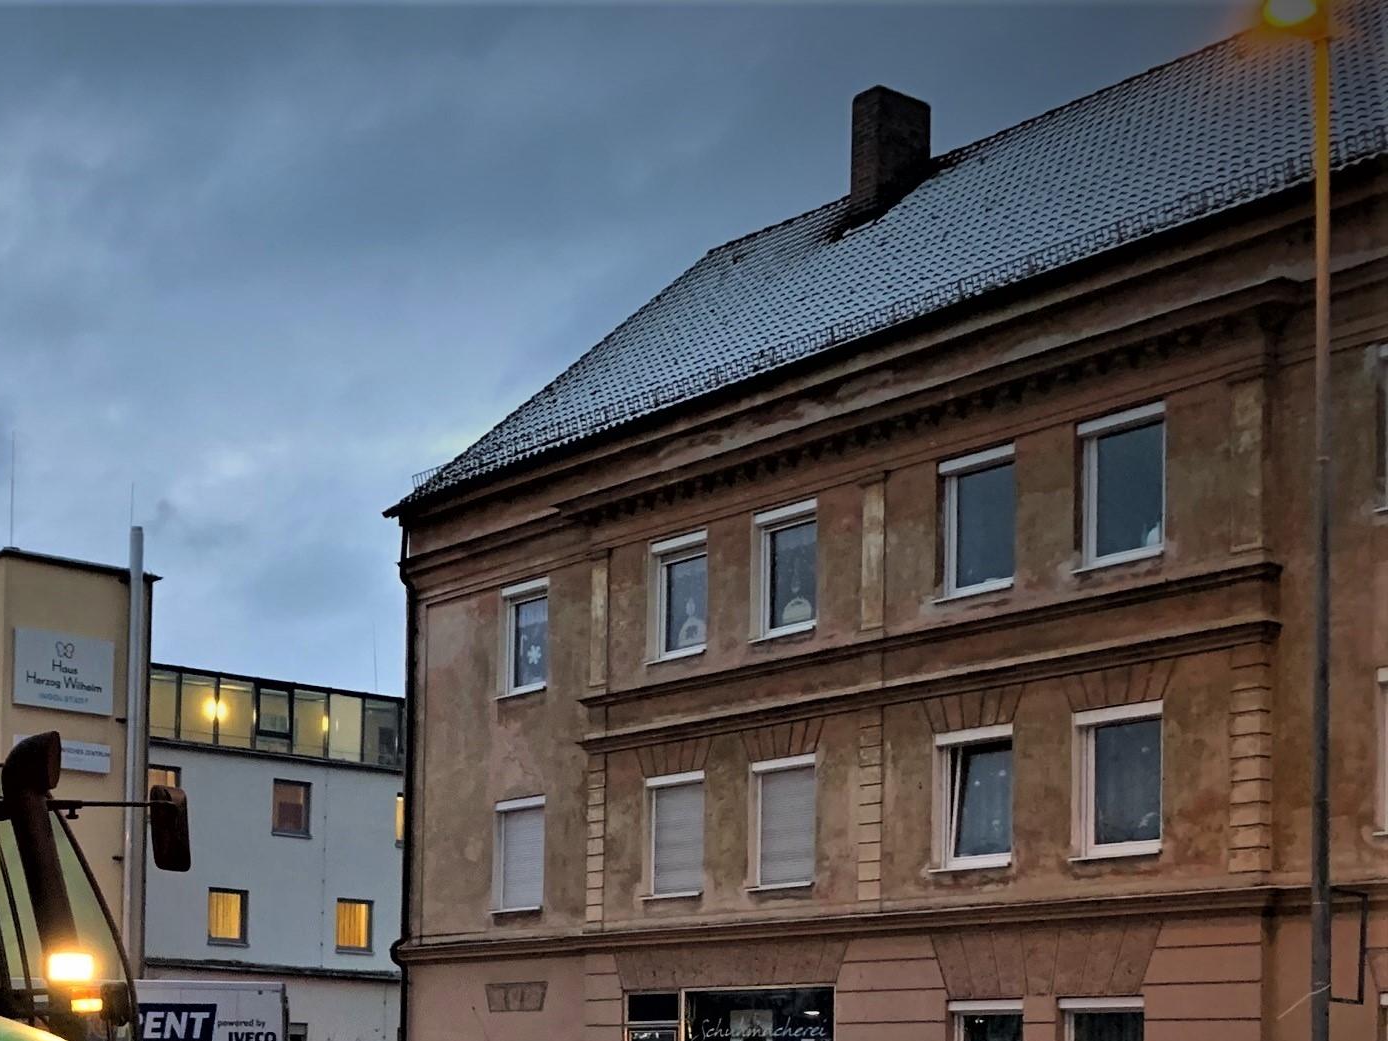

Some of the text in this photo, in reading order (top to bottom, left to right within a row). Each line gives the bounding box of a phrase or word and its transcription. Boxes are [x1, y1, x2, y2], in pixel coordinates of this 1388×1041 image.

[52, 659, 78, 675] Haus
[26, 670, 103, 693] Herzog Wilhelm
[217, 1018, 254, 1030] powered
[255, 1018, 267, 1029] by
